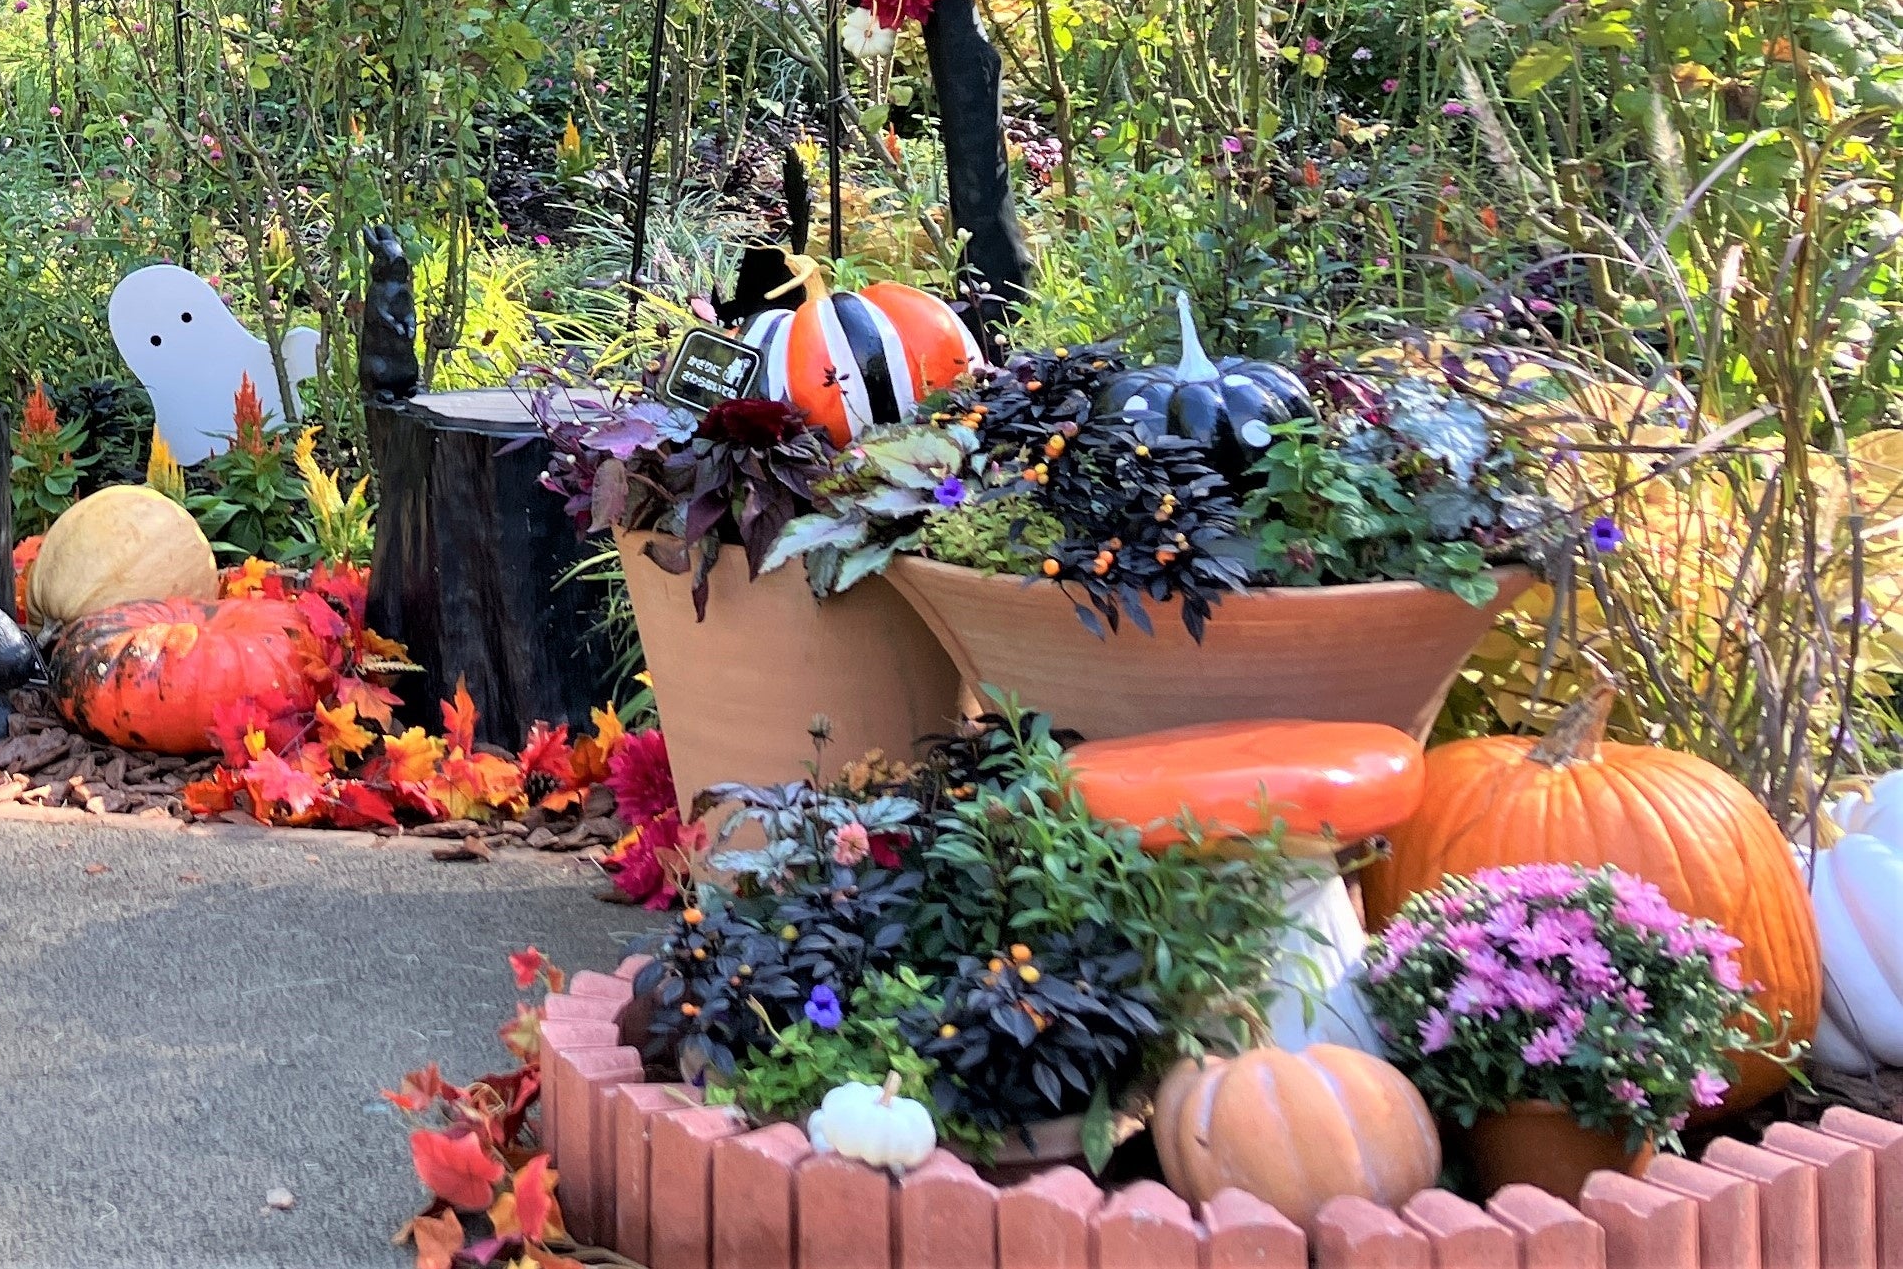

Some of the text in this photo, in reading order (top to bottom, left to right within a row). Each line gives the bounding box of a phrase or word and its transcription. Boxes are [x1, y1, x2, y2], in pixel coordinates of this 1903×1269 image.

[686, 354, 722, 377] かざりに
[681, 370, 738, 400] さわらないでね
